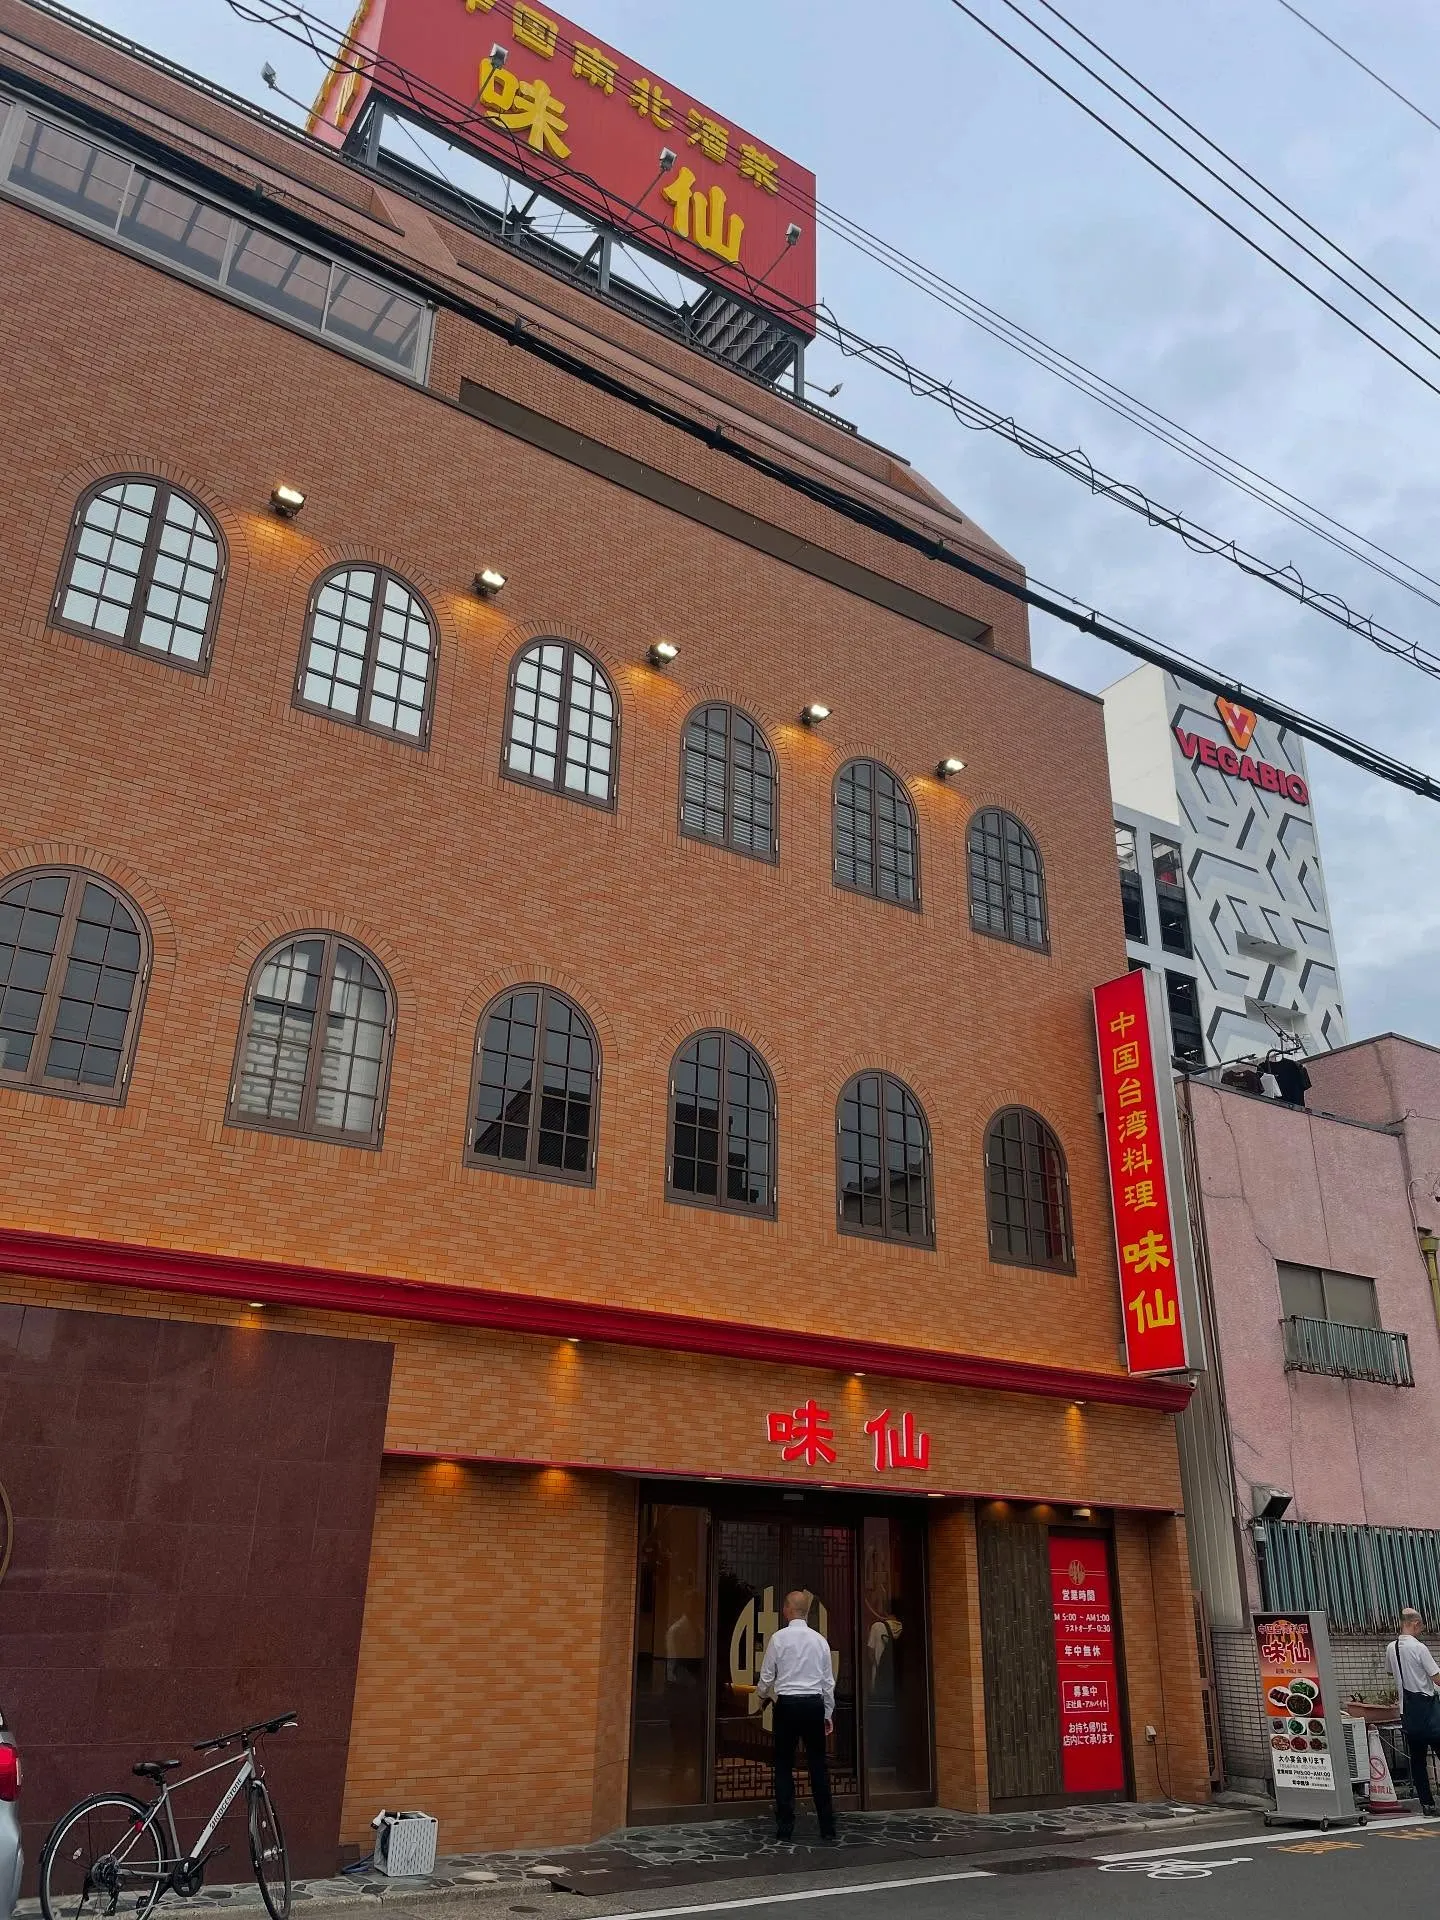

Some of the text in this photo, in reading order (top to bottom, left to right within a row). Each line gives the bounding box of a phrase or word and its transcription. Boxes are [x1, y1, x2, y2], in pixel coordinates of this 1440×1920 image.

[478, 56, 746, 264] 味仙
[1174, 726, 1309, 806] VEGABIO
[1109, 1011, 1176, 1334] 中国台湾料理 味仙
[766, 1400, 931, 1471] 味仙
[1062, 1588, 1096, 1602] 営業時間
[1062, 1613, 1077, 1621] 5:00
[1065, 1645, 1101, 1657] 年中無休
[1261, 1640, 1311, 1664] 味仙
[1073, 1685, 1098, 1697] 募集中
[1068, 1721, 1108, 1733] お持ち帰りは
[1063, 1733, 1115, 1746] 店内にて承ります
